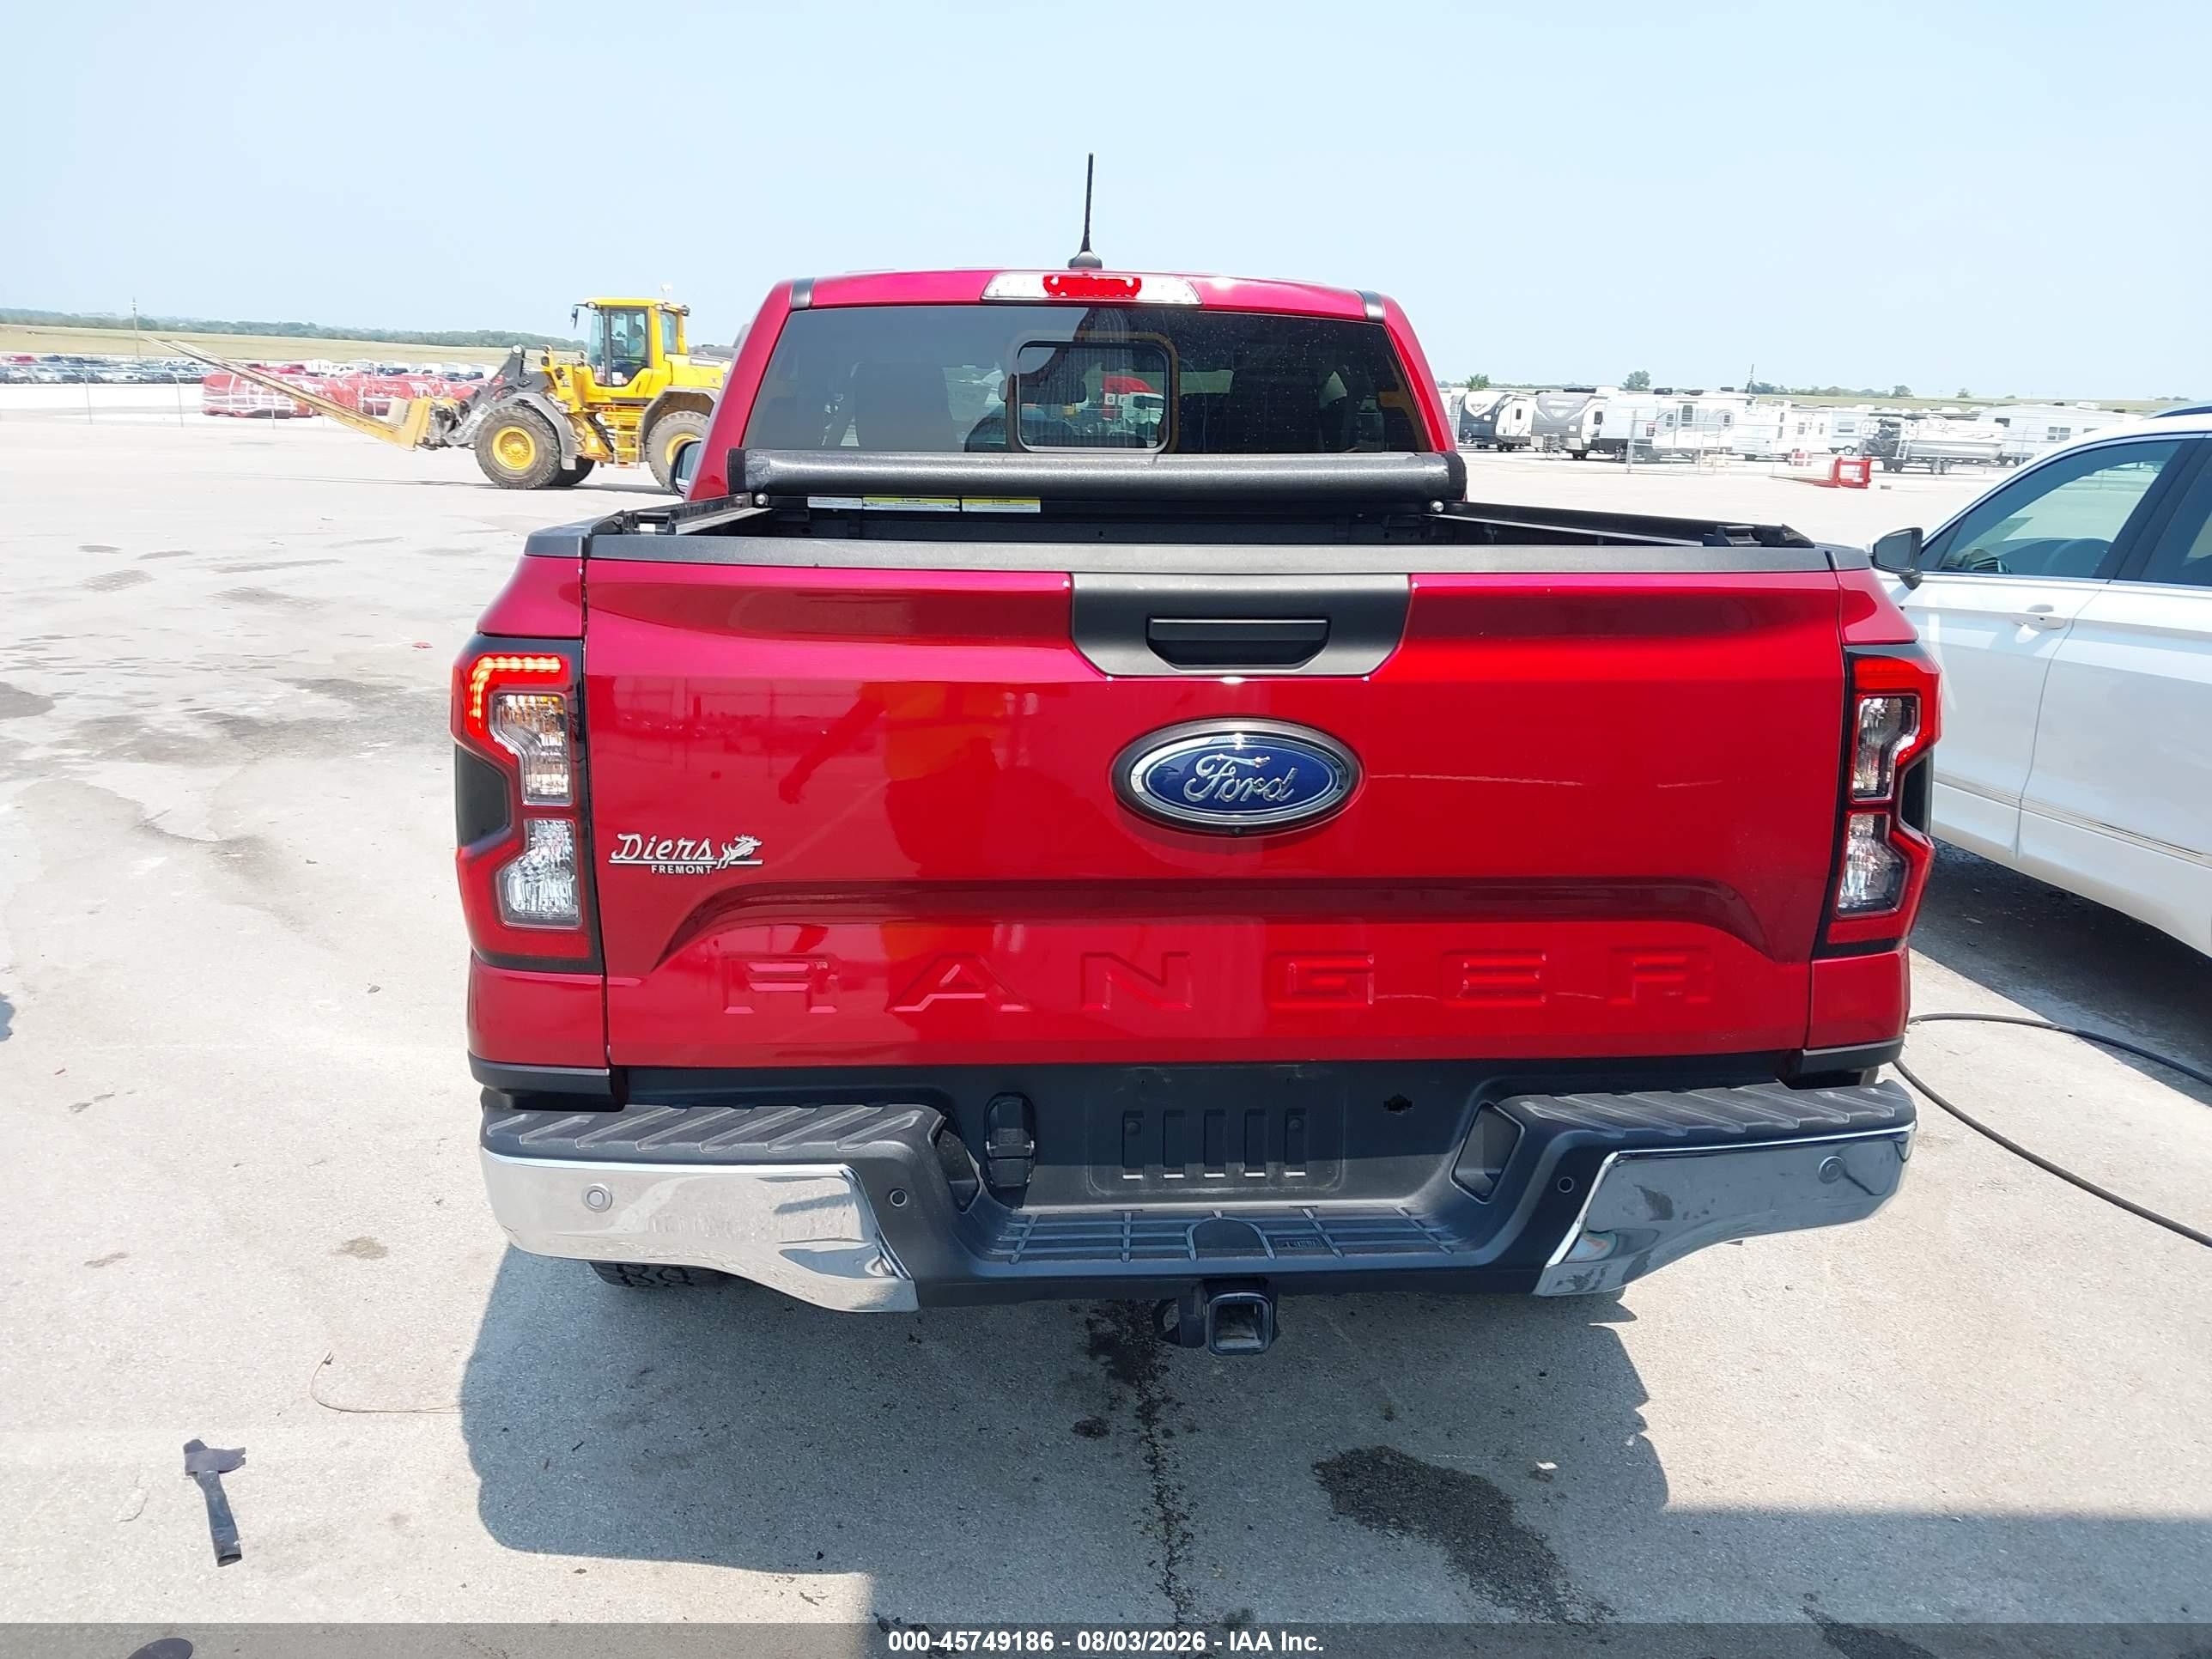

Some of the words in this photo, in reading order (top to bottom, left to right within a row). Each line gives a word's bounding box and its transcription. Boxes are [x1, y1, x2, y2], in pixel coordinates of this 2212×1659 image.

[1183, 753, 1297, 802] Ford
[611, 833, 716, 860] Diers
[651, 865, 713, 875] FREMONT
[723, 950, 1712, 1015] RANGER
